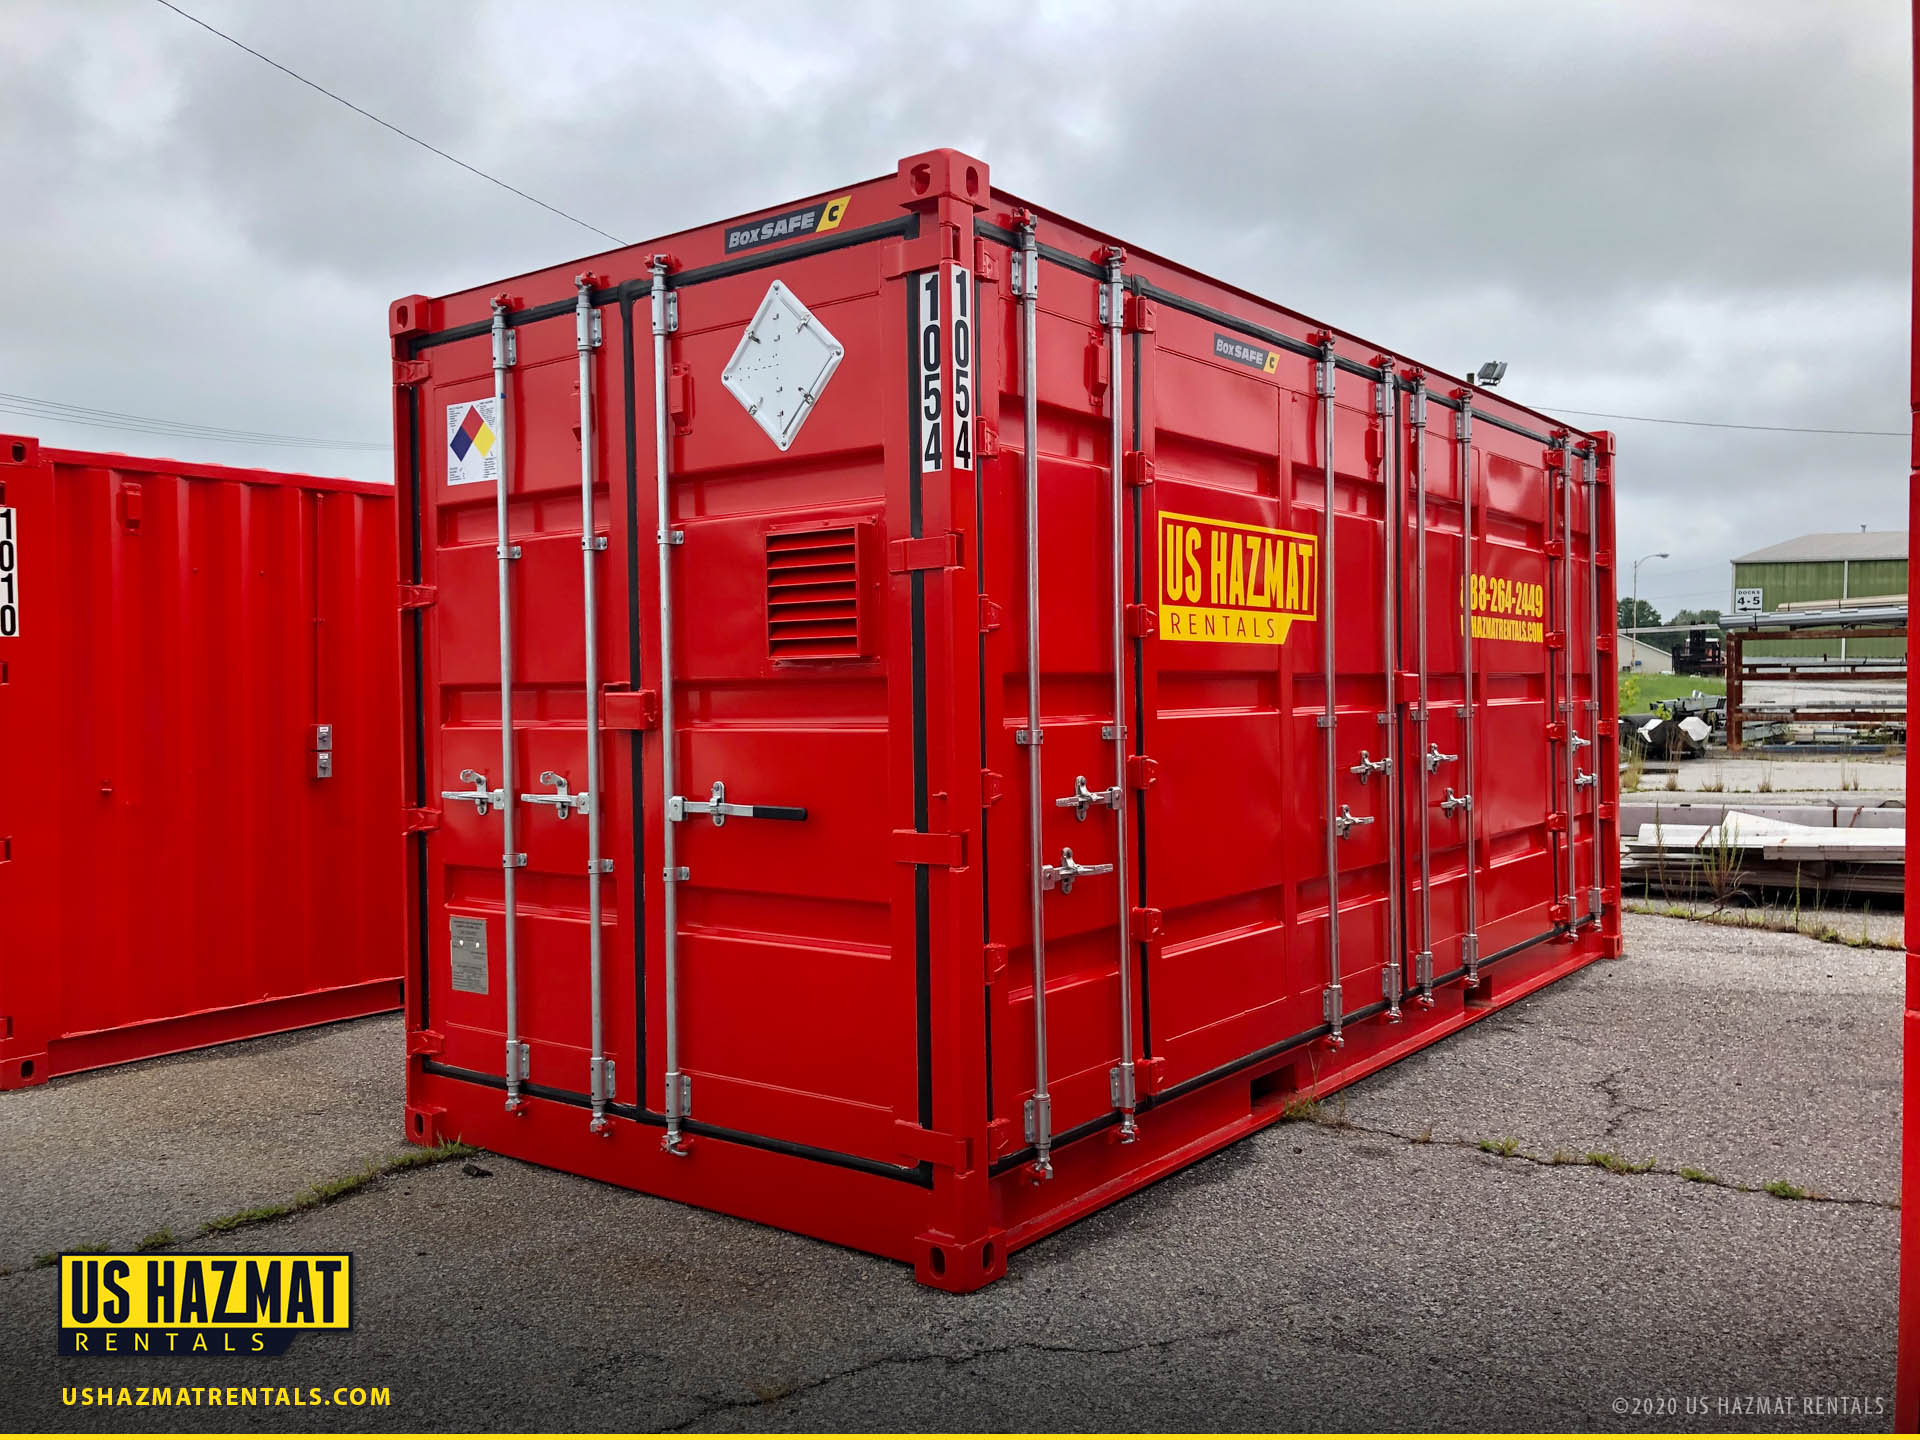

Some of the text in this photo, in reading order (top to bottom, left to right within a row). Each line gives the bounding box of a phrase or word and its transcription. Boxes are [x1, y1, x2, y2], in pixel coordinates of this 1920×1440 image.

[827, 205, 840, 222] C
[923, 273, 941, 470] 1054
[954, 269, 971, 469] 1054
[1269, 356, 1275, 369] C
[0, 508, 16, 636] 1010
[1166, 523, 1313, 611] US HAZMAT
[1171, 612, 1275, 638] RENTALS
